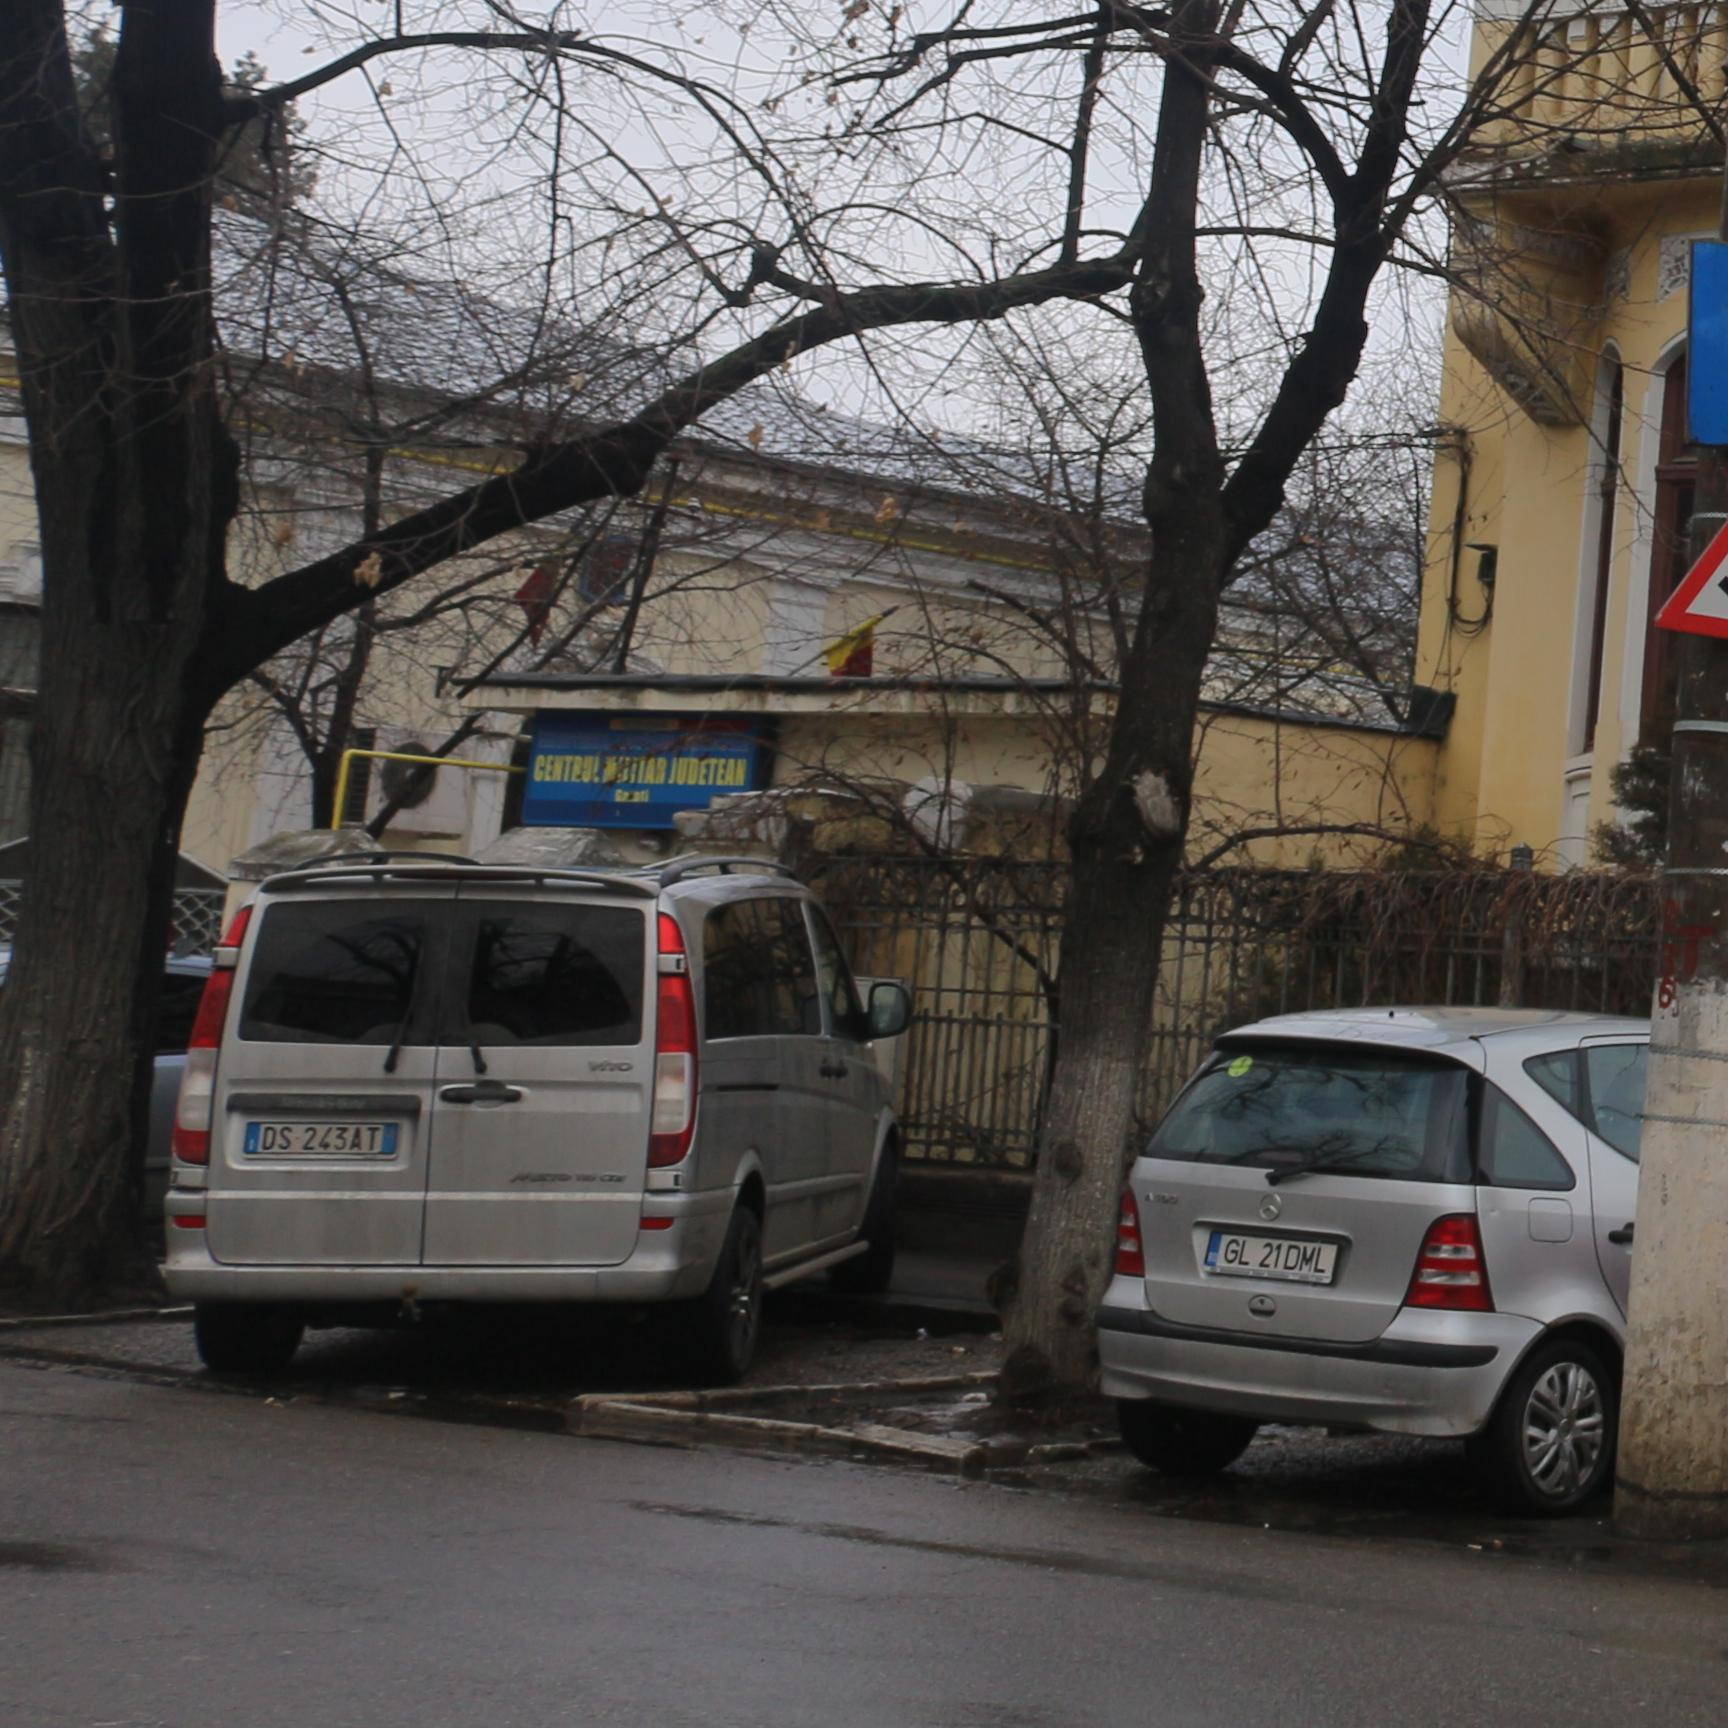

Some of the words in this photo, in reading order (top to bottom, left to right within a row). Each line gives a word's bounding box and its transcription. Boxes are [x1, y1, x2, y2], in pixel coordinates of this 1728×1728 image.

[533, 754, 599, 784] CENTRUL
[261, 1125, 293, 1151] DS
[302, 1125, 381, 1152] 243AT
[1223, 1238, 1250, 1267] GL
